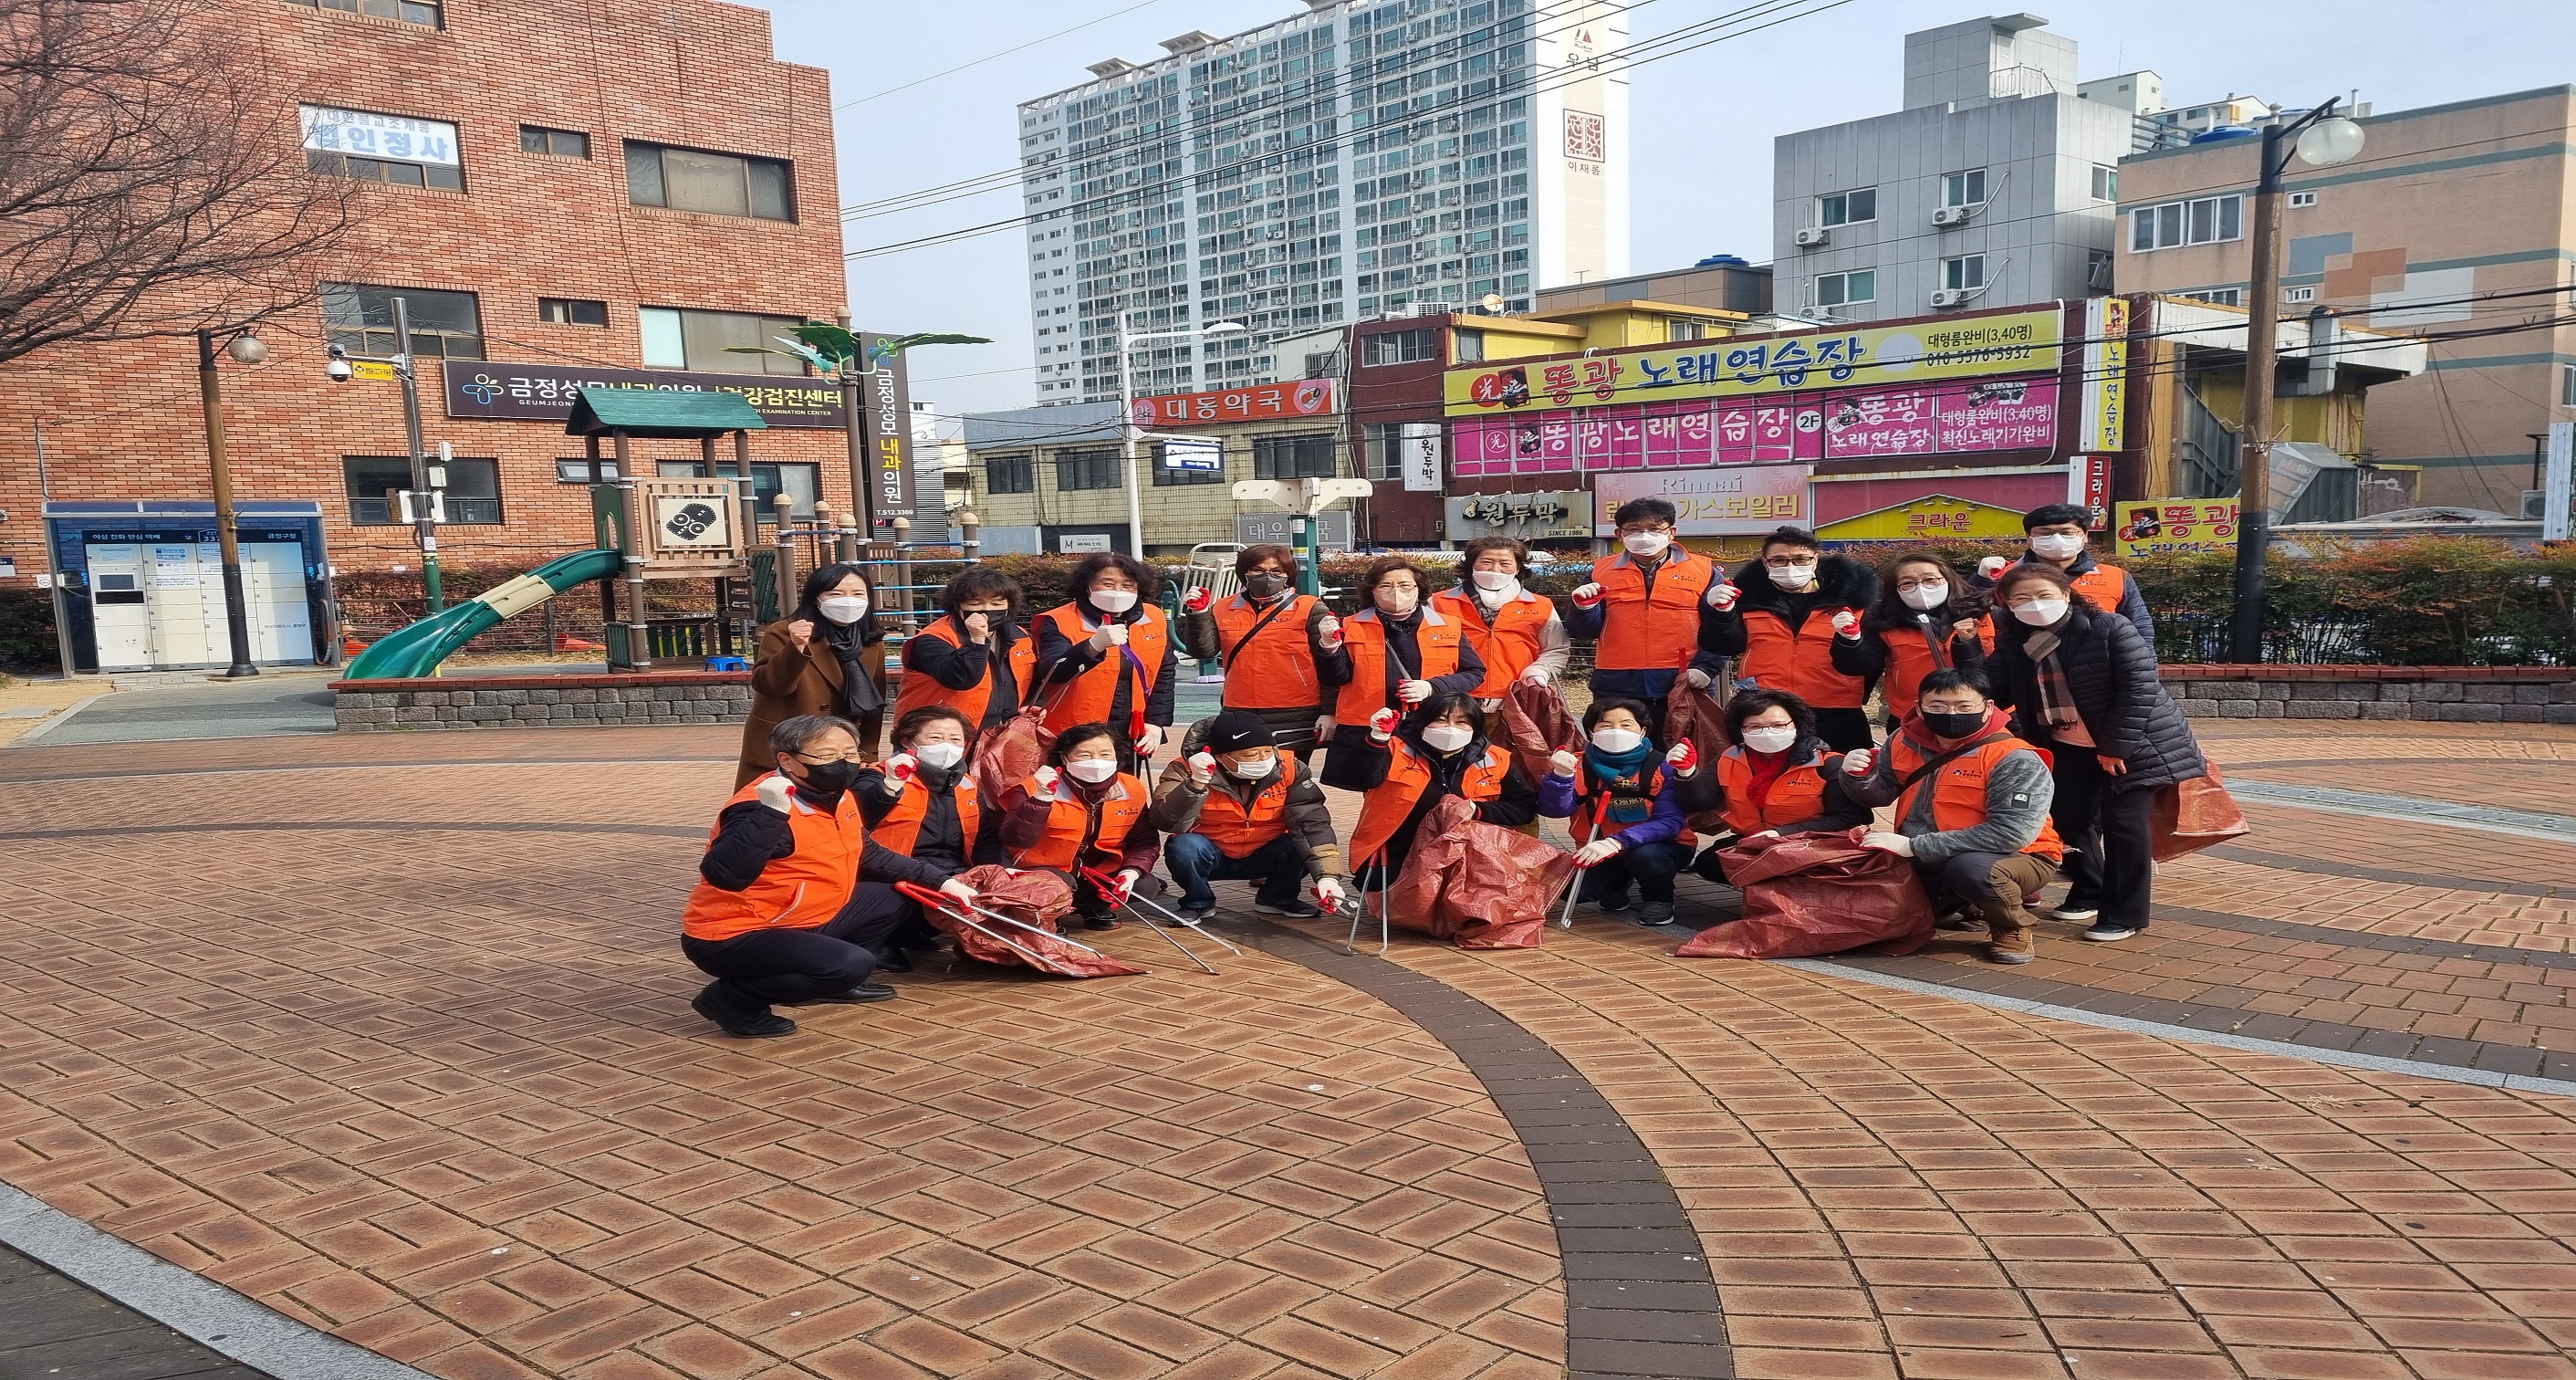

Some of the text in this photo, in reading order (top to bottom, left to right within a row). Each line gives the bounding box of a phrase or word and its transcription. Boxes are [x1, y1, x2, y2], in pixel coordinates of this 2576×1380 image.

[1928, 324, 2032, 348] 대형룸완비(3,40명)
[1636, 336, 1866, 387] 노래연습장
[1165, 390, 1283, 421] 대동약국
[2104, 345, 2120, 446] 노래연습장
[1799, 414, 1820, 428] 2F
[1421, 439, 1434, 481] 원두막
[1656, 474, 1742, 495] Rinnai
[2090, 461, 2104, 516] 크라운
[1482, 502, 1559, 527] 원두막
[1677, 494, 1799, 519] 가스보일러
[1248, 520, 1333, 540] 대우국
[1906, 512, 1972, 532] 크라운
